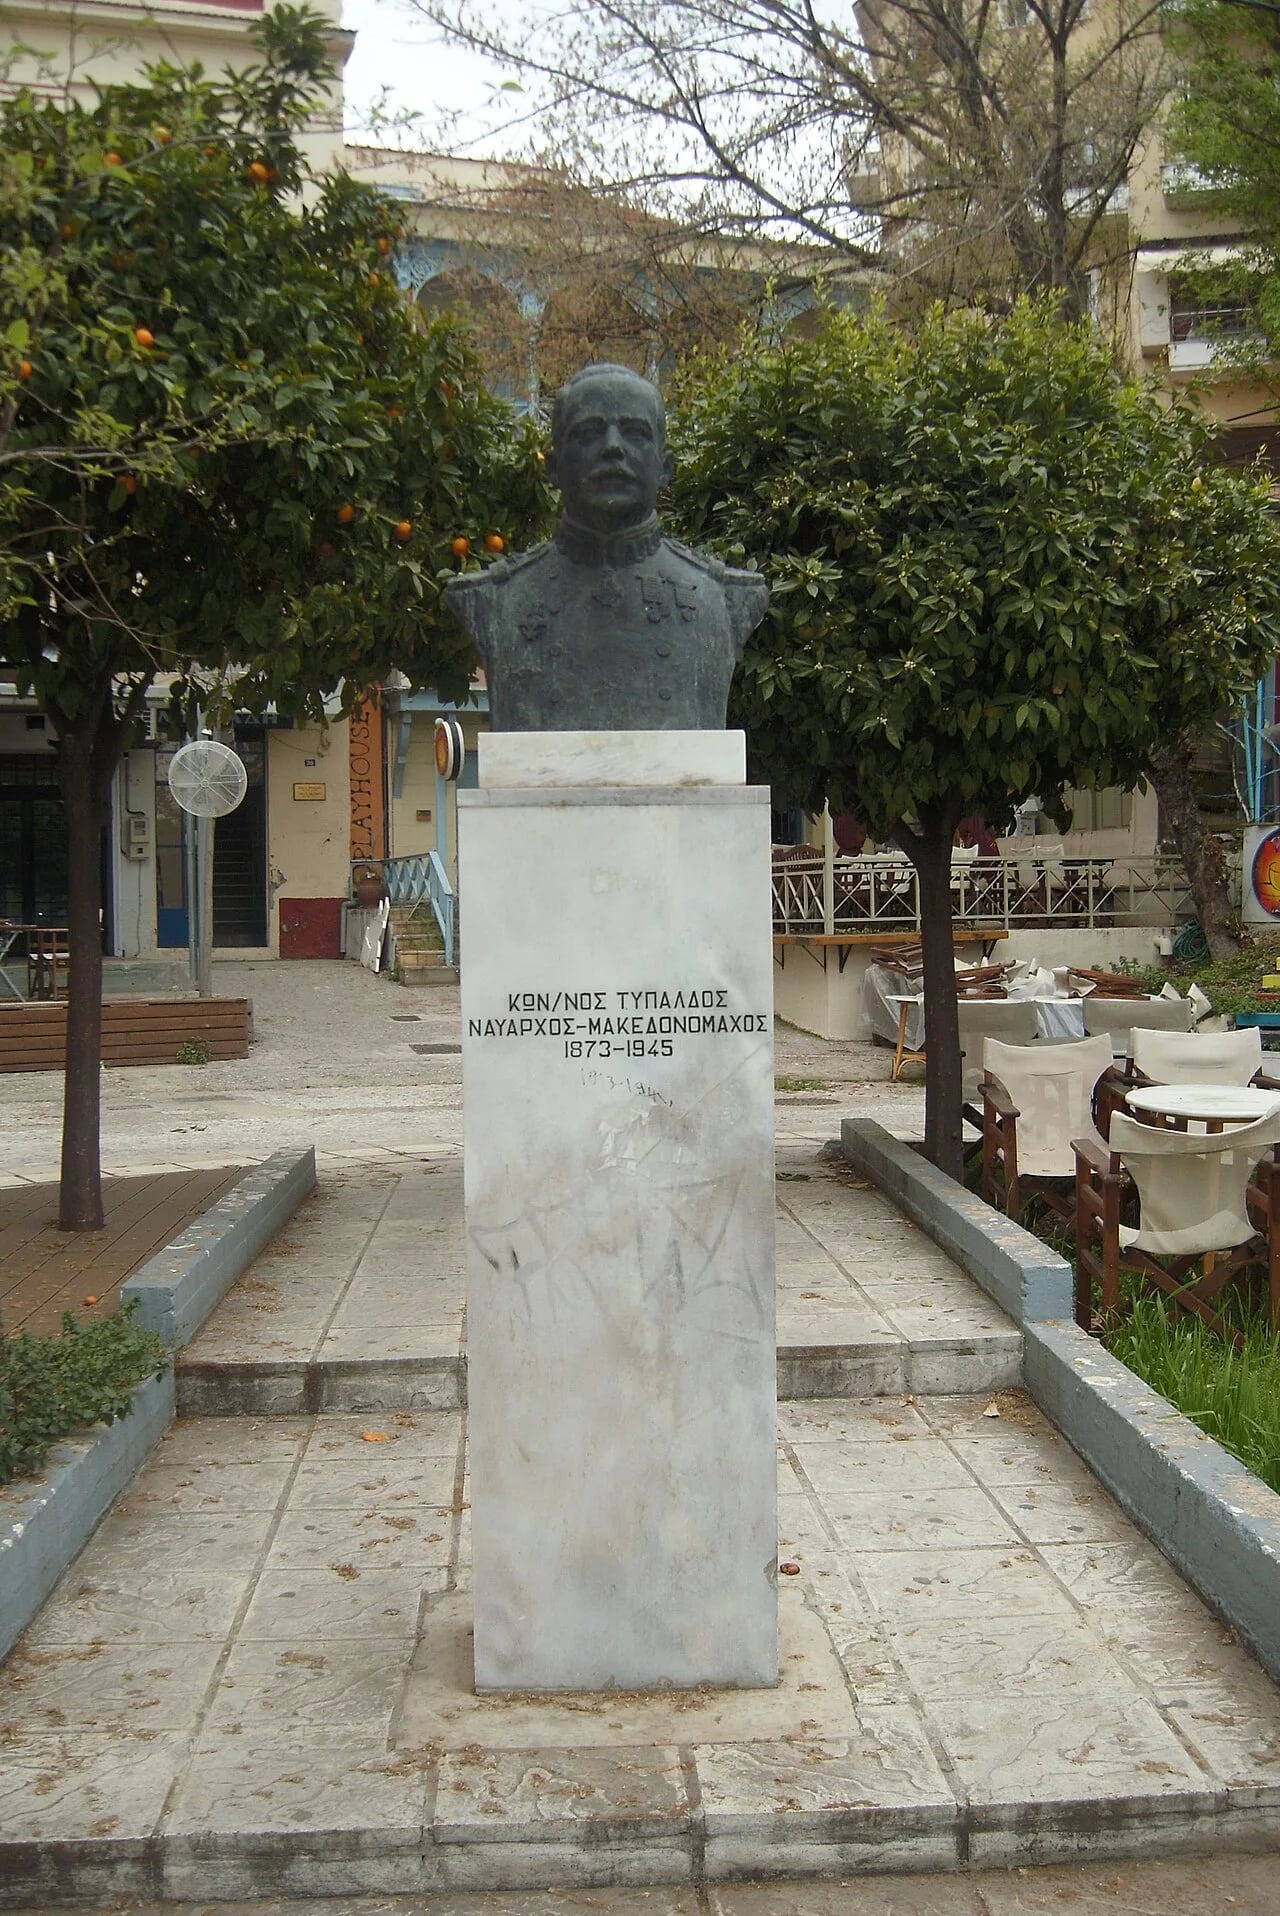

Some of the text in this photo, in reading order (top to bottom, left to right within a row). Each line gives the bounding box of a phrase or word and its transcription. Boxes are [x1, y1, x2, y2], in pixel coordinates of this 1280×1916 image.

[350, 711, 372, 860] PLAYHOUSE
[508, 990, 728, 1012] ΚΩΝ/ΝΟΣ ΤΥΠΑΛΔΟΣ
[468, 1014, 768, 1037] ΝΑΥΑΡΧΟΣ-ΜΑΚΕΔΟΝΟΜΑΧΟΣ
[564, 1039, 674, 1058] 1873-1945
